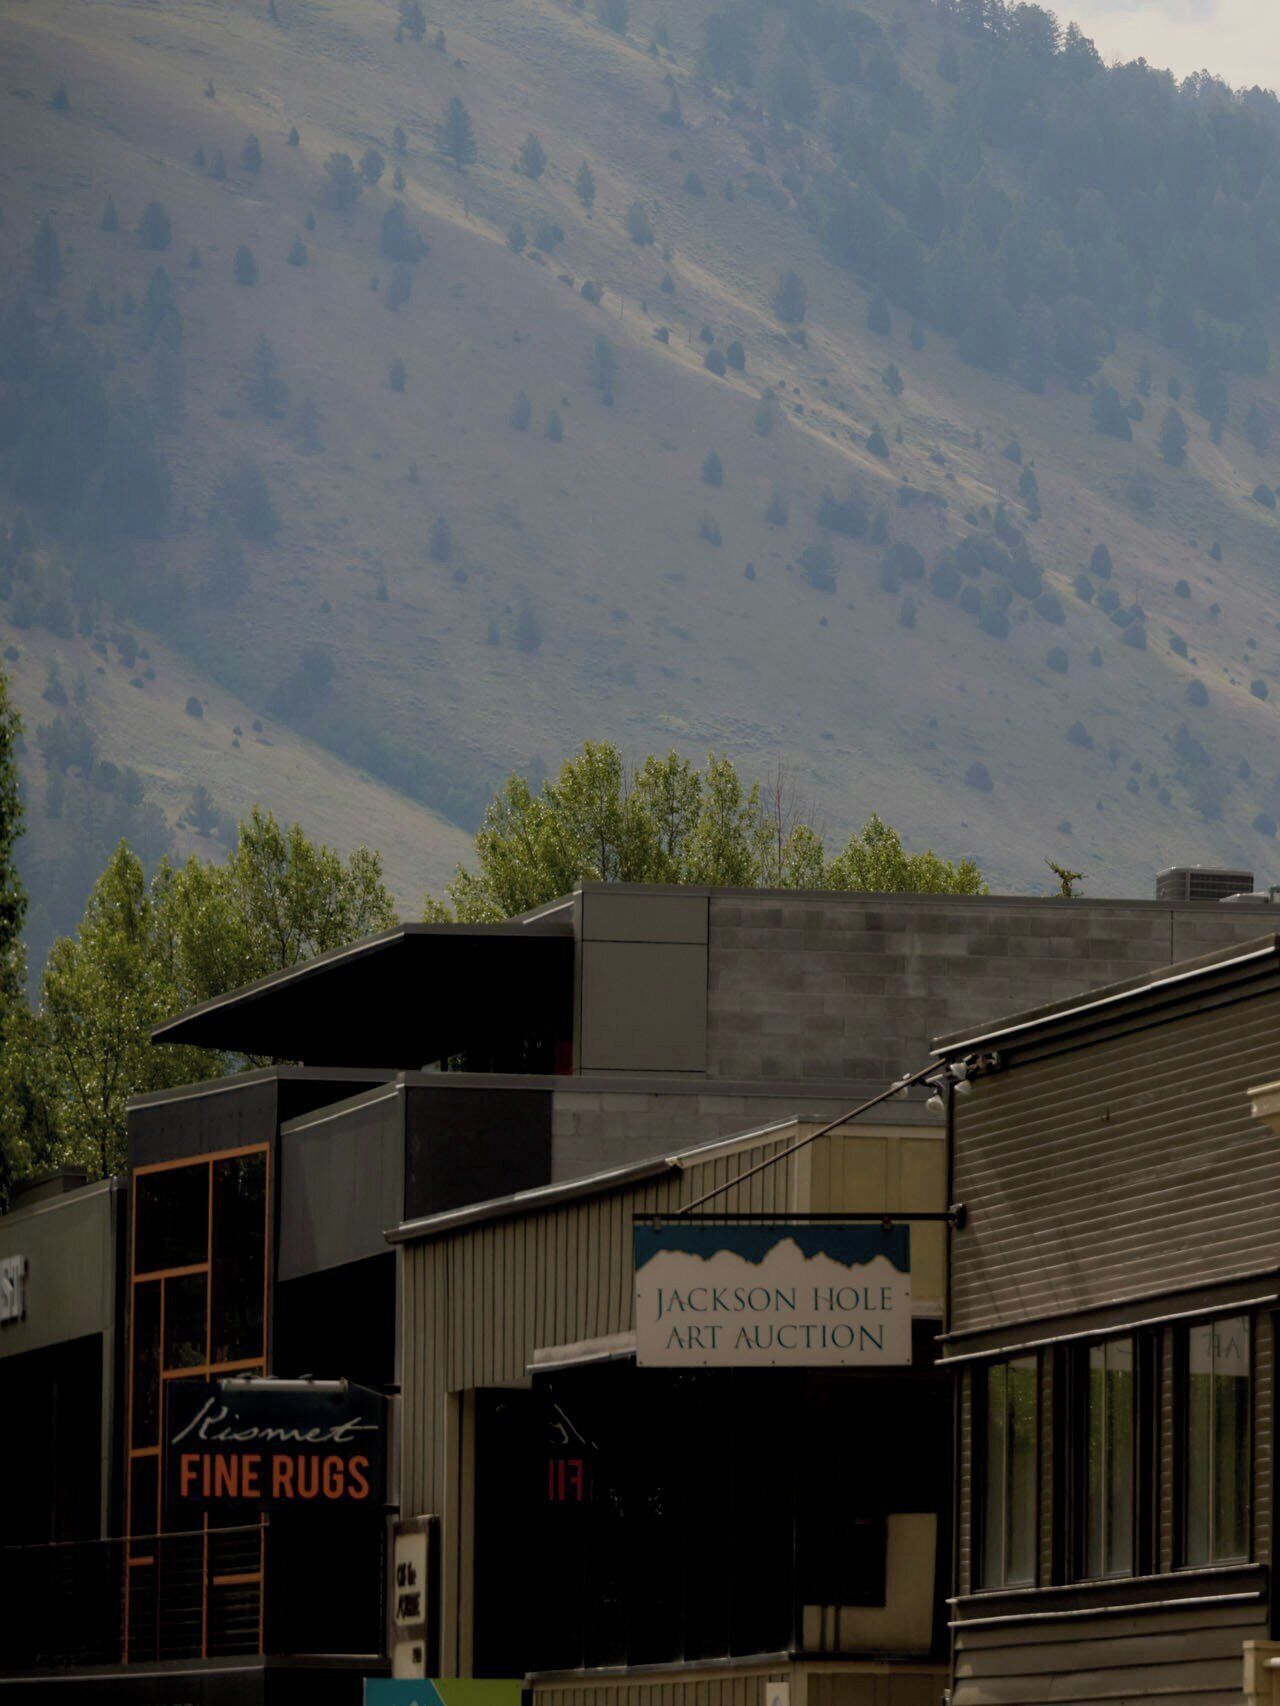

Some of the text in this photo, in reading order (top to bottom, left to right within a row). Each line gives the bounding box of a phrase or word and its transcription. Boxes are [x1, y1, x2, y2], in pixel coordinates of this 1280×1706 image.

[657, 1287, 893, 1320] JACKSON HOLE
[666, 1324, 884, 1351] ART AUCTION
[172, 1396, 379, 1444] Kismet
[180, 1453, 369, 1500] FINE RUGS
